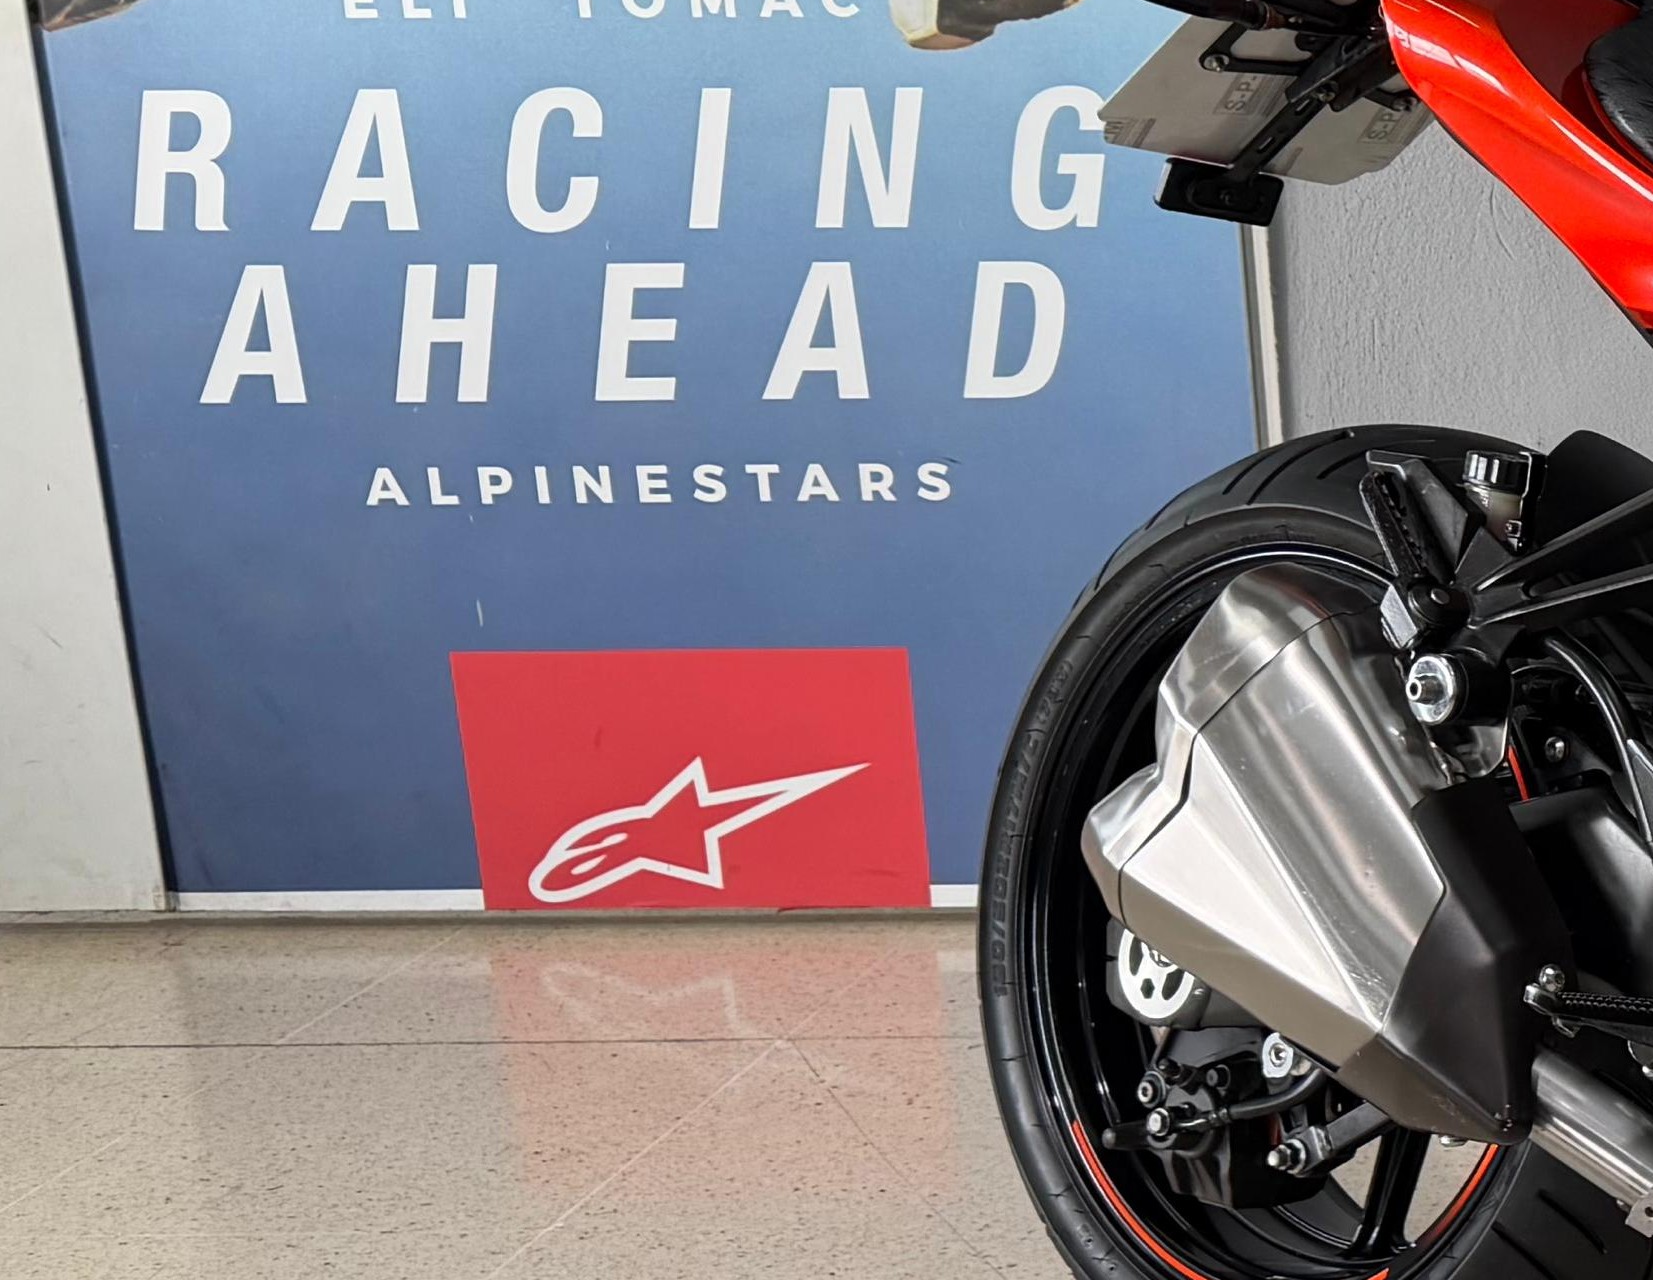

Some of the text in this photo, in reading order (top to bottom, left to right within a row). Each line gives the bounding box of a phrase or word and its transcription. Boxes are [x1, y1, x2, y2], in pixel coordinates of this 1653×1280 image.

[133, 86, 1110, 233] RACING
[200, 261, 1068, 404] AHEAD
[365, 462, 955, 508] ALPINESTARS
